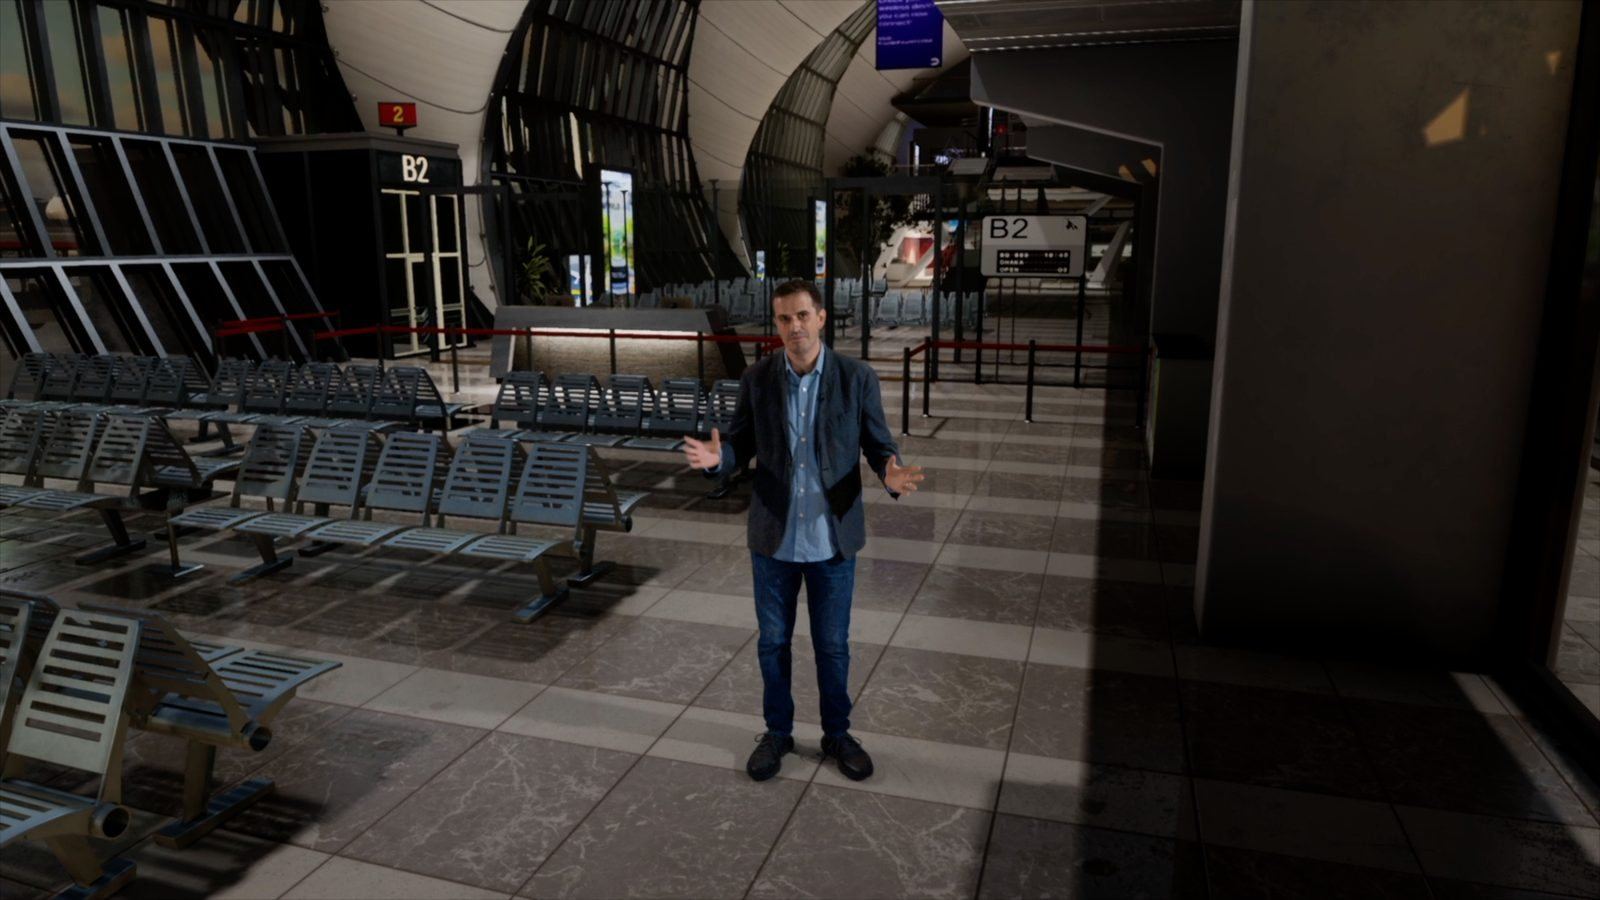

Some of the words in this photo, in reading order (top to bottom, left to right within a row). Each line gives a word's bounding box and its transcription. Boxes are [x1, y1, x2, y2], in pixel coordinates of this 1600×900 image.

[393, 105, 404, 122] 2
[401, 154, 430, 183] B2
[990, 218, 1028, 239] B2
